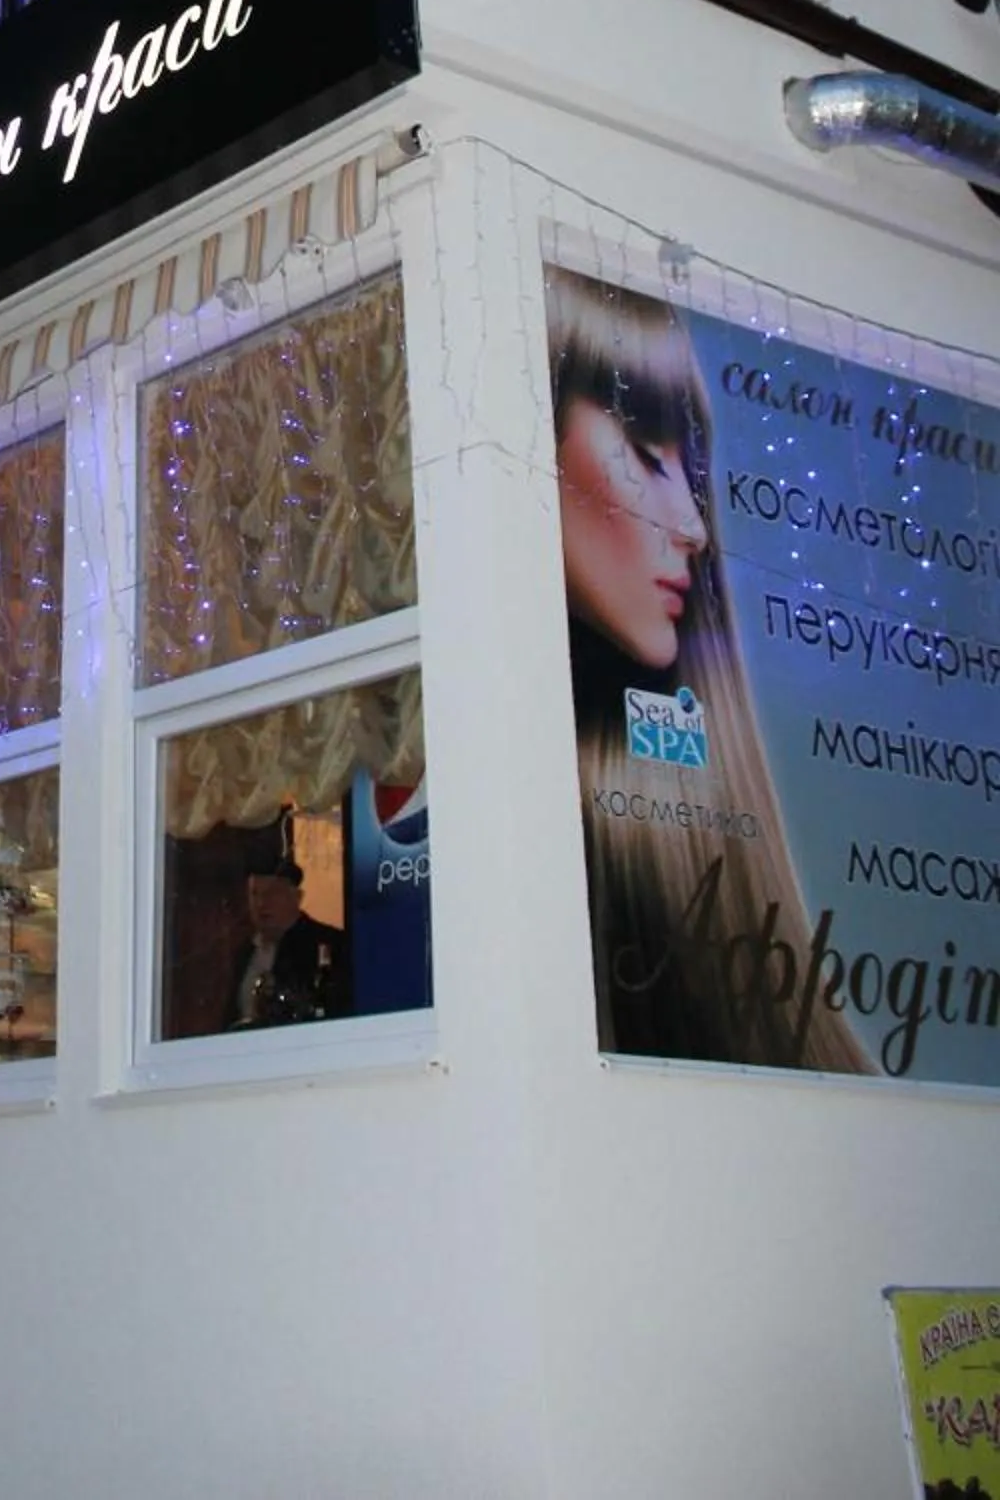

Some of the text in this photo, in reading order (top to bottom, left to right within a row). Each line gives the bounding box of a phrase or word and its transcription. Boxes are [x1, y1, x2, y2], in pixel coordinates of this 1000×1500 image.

[721, 362, 1000, 477] салон краси
[765, 594, 1000, 687] перукарня
[627, 691, 676, 729] Sea
[632, 722, 705, 769] SPA
[812, 716, 1000, 802] манікюр
